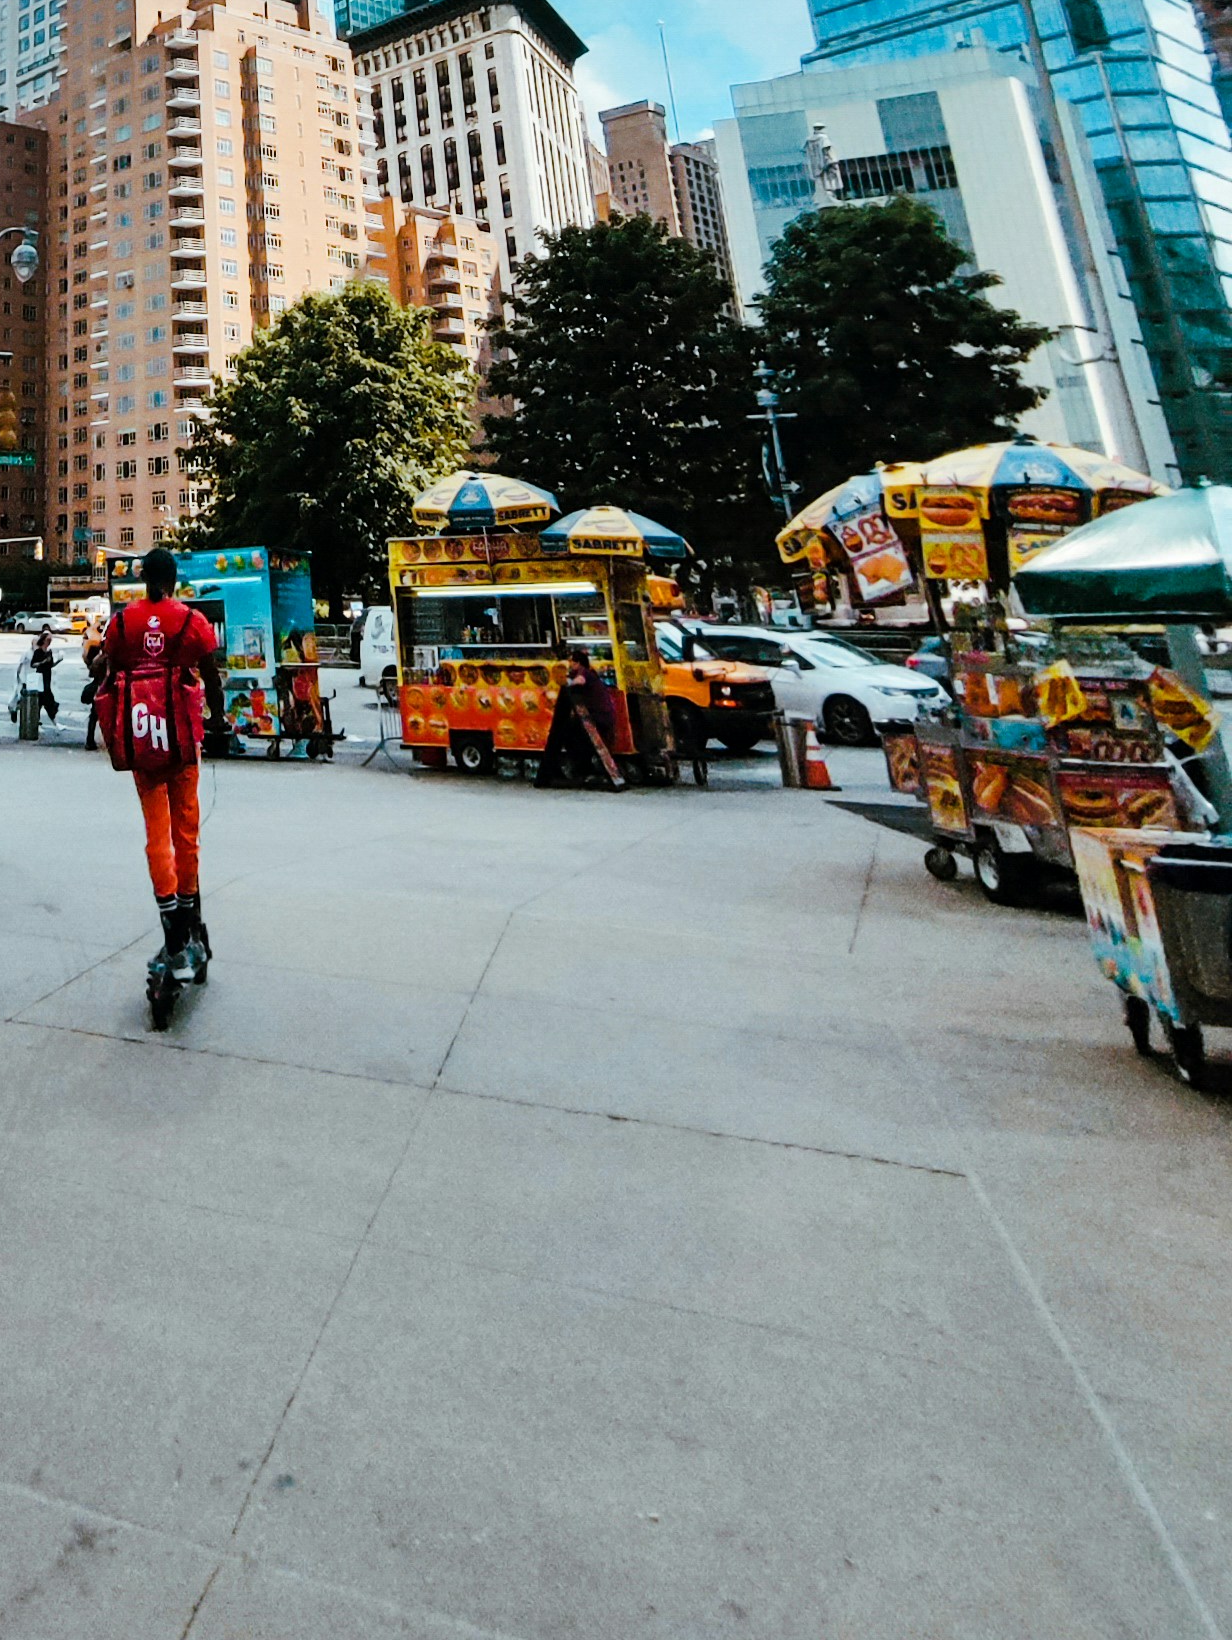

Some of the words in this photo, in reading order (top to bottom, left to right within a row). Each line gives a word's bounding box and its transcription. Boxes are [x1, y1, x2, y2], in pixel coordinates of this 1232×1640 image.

[497, 506, 547, 521] SABRETT
[572, 538, 640, 552] SABRETT
[131, 702, 170, 752] GH
